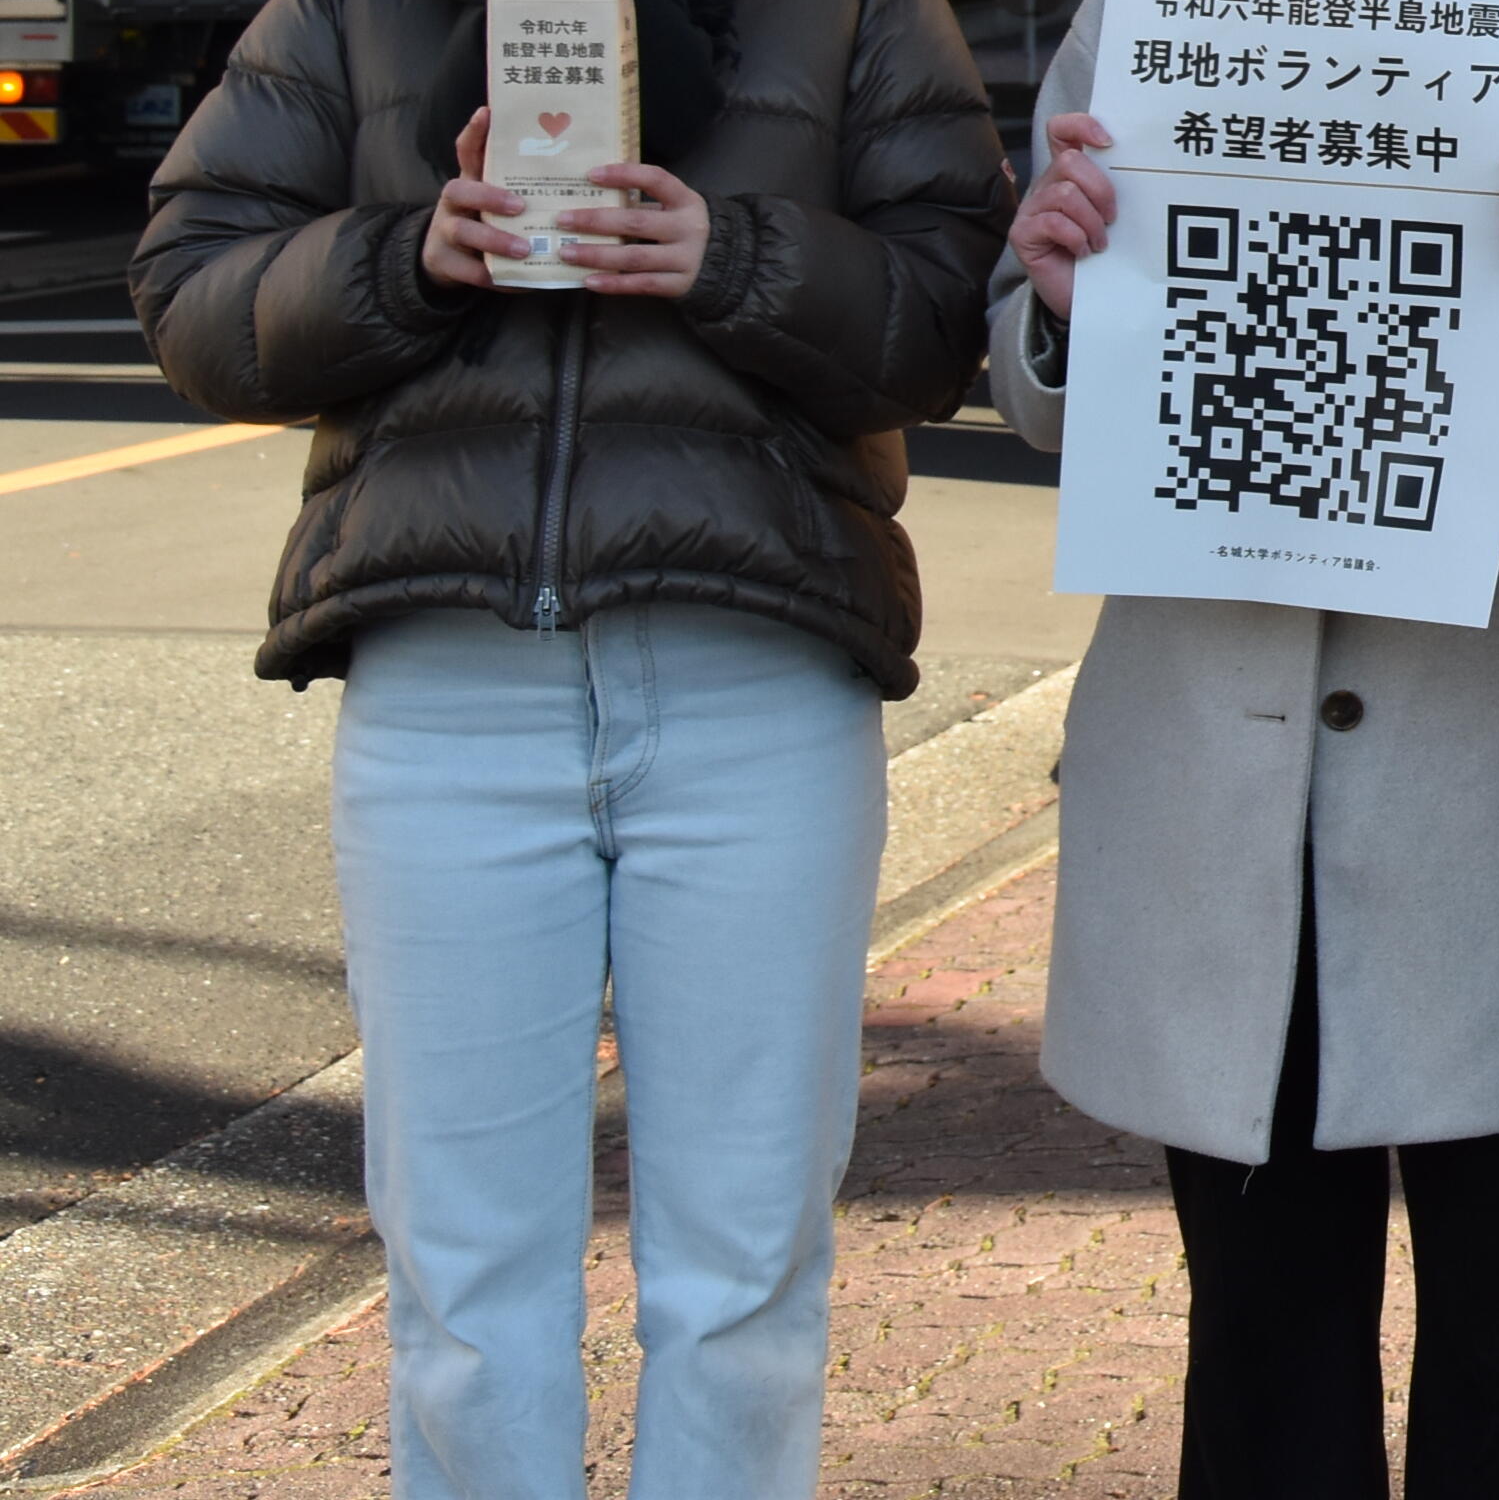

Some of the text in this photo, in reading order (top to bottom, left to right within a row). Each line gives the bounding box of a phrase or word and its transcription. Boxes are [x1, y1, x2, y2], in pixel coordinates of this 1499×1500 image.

[520, 19, 587, 35] 令和六年
[503, 42, 605, 58] 能登半島地震
[504, 66, 604, 84] 支援金募集
[1174, 111, 1458, 173] 希望者募集中
